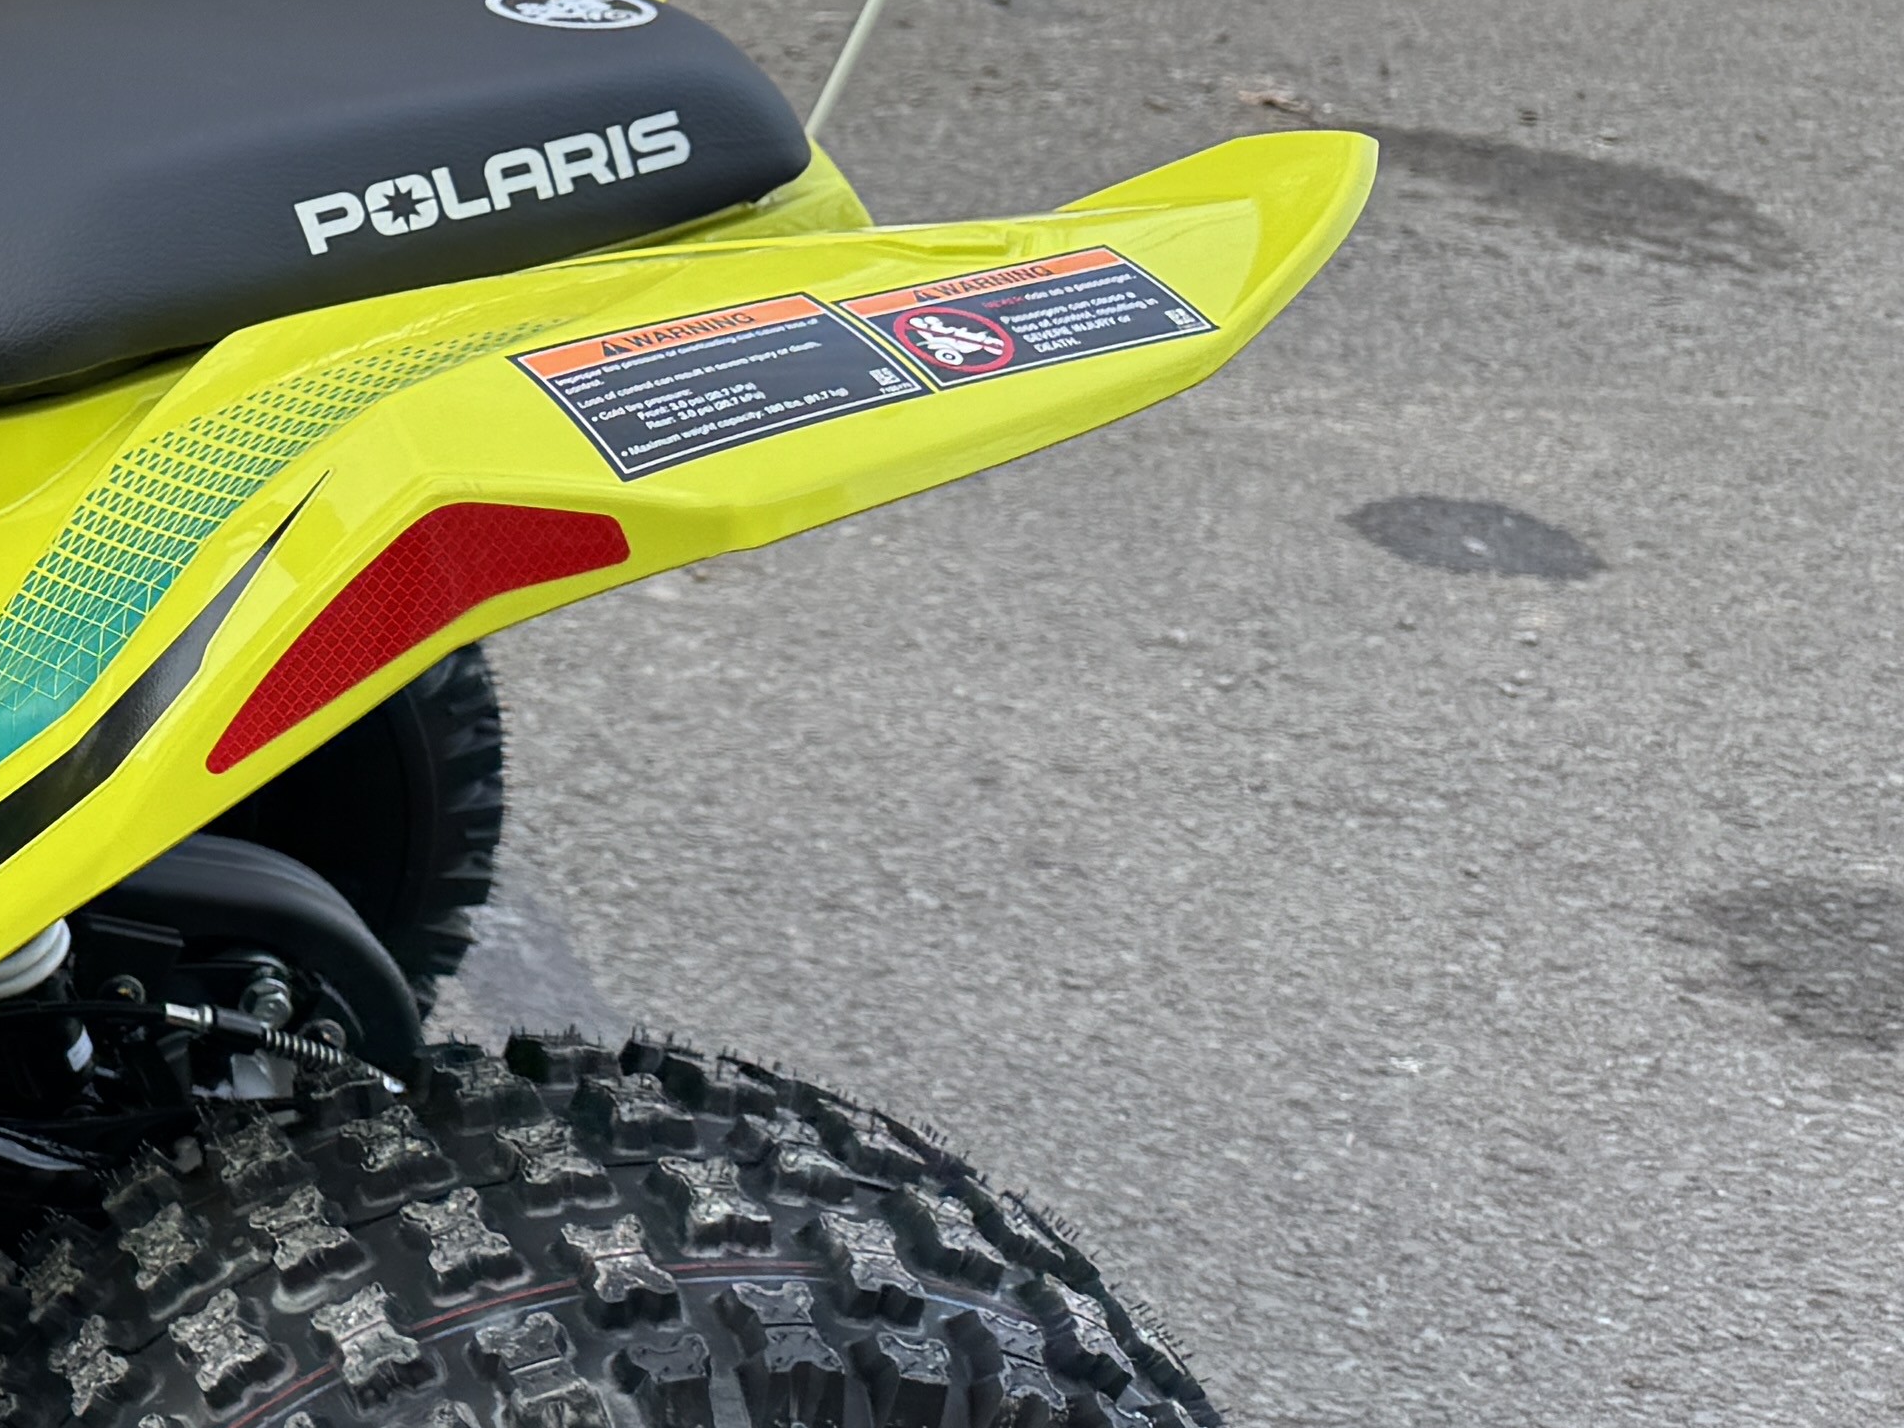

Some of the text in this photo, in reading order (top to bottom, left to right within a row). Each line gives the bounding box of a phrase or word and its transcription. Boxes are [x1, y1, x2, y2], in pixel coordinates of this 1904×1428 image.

[294, 110, 691, 256] POLARIS
[933, 264, 1054, 297] WARNING
[623, 311, 757, 348] WARNING
